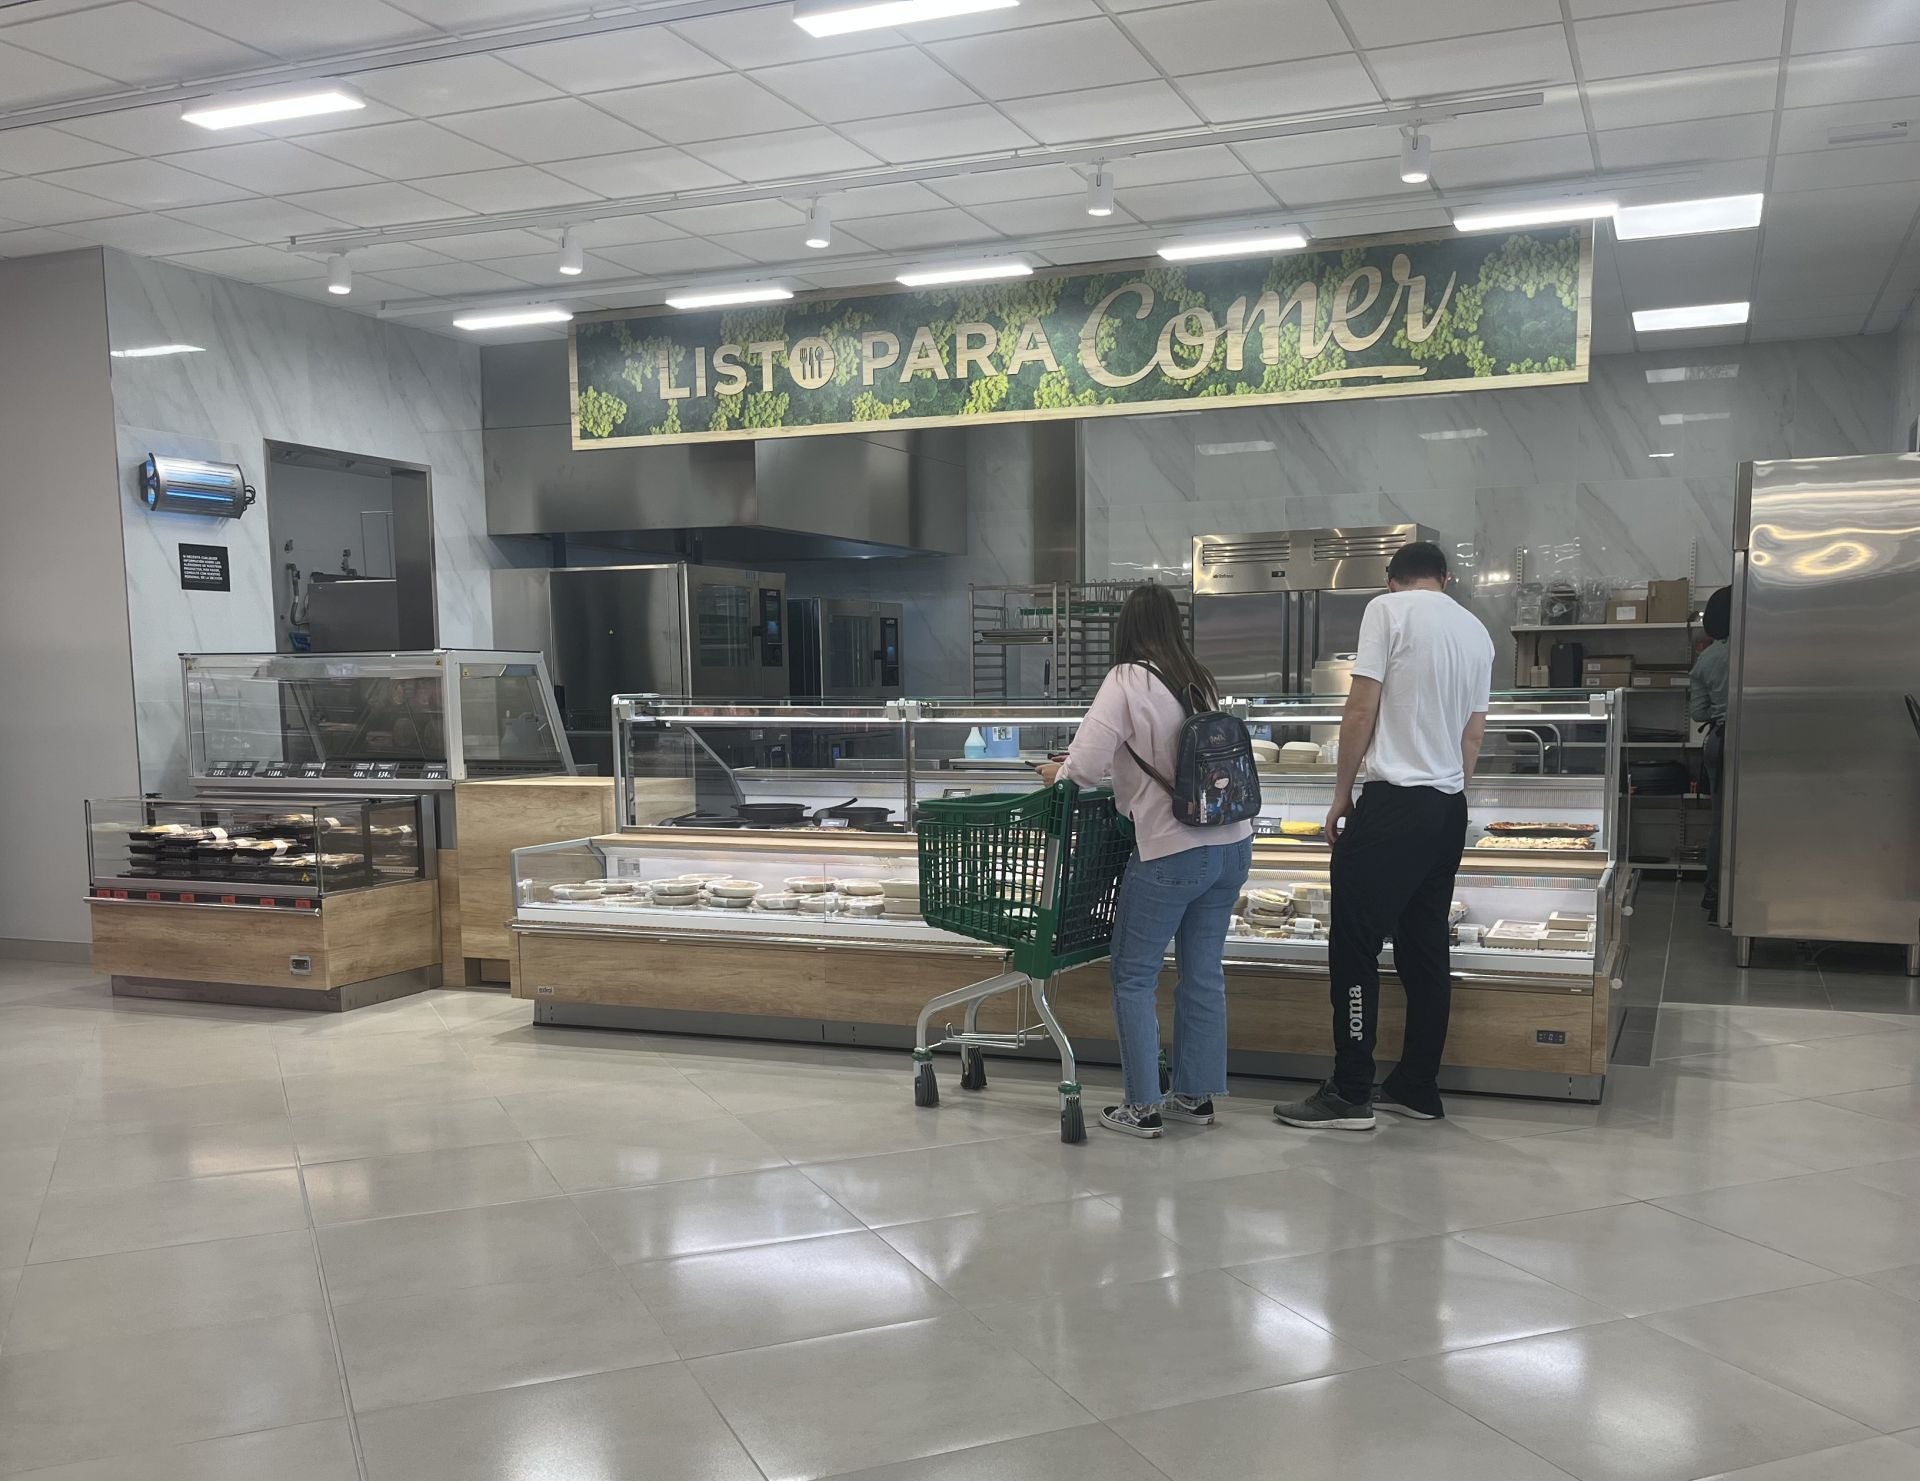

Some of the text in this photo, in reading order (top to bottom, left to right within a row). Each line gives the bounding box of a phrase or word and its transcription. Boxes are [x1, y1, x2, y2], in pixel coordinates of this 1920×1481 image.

[659, 253, 1457, 400] LISTO PARA Comer
